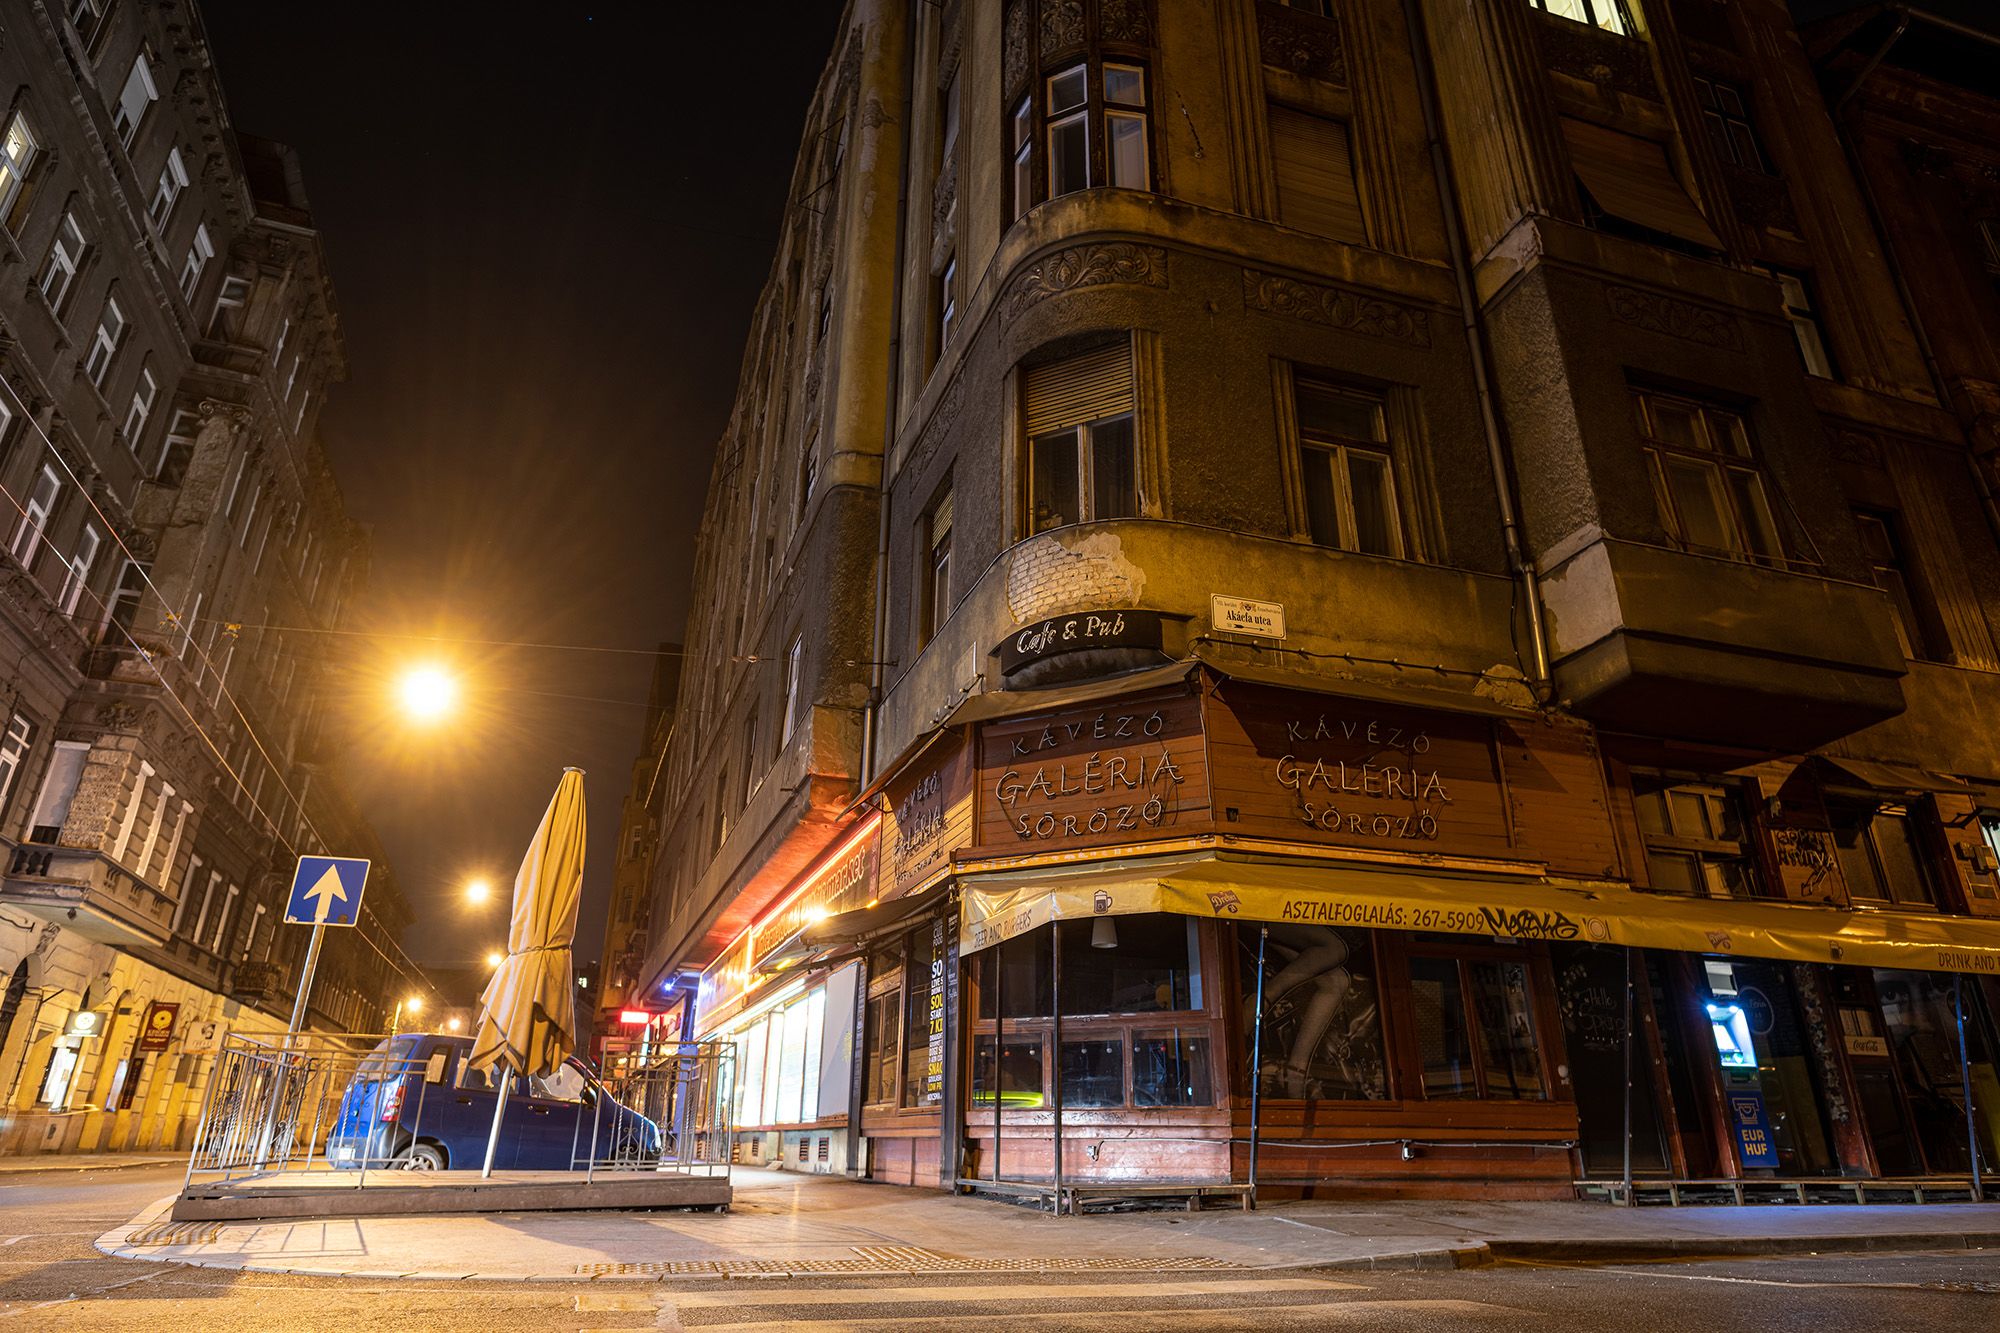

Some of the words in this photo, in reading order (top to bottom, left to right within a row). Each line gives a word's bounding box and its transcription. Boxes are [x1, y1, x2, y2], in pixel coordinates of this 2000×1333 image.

[1062, 620, 1078, 640] &
[1085, 612, 1125, 638] Pub
[1226, 610, 1253, 623] Akácfa
[1255, 616, 1272, 626] utca
[1011, 709, 1163, 757] KÁVÉZÓ
[1286, 714, 1430, 753] KÁVÉZÓ
[996, 750, 1185, 807] GALÉRIA
[1276, 755, 1453, 801] GALÉRIA
[1282, 900, 1407, 926] ASZTALFOGLALÁS:
[1413, 909, 1485, 931] 267-5909
[989, 922, 1002, 943] AND
[1937, 952, 1972, 969] DRINK
[1975, 955, 1995, 970] AND
[1741, 1129, 1766, 1141] EUR
[1744, 1142, 1768, 1156] HUF
